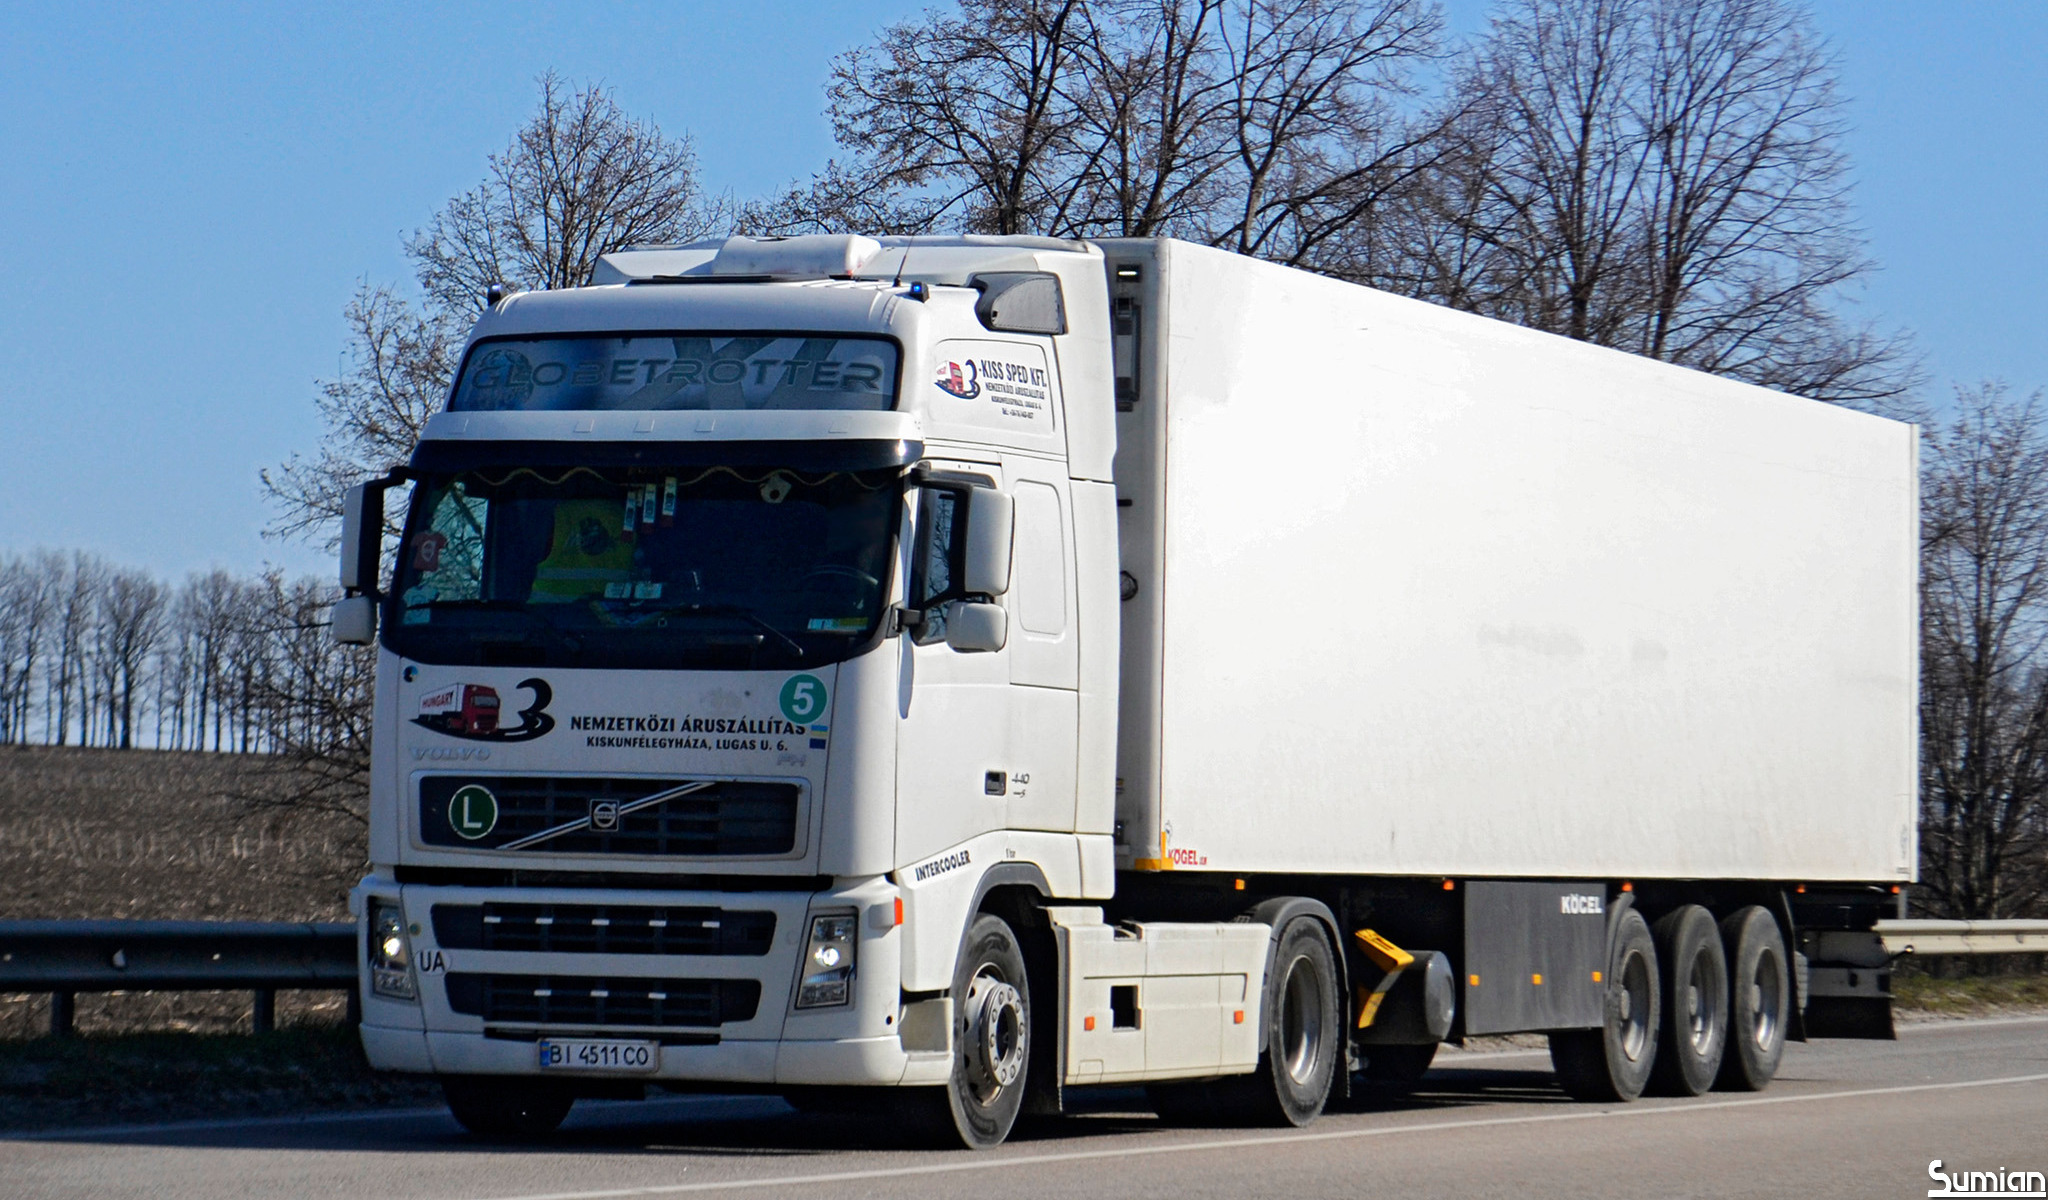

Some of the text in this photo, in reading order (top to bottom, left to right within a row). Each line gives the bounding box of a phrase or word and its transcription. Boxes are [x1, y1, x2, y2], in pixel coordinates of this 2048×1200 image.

[471, 358, 882, 391] GLOBETROTTER
[981, 359, 1004, 380] KISS
[1006, 363, 1028, 384] SPED
[791, 682, 814, 715] 5
[570, 714, 676, 732] NEMZETKÖZI
[586, 735, 789, 751] KISKUNFÉLEGYHÁZA, LUGAS U. 6.
[408, 747, 491, 761] VOLVO
[463, 795, 483, 828] L
[915, 850, 971, 881] INTERCOOLER
[1561, 893, 1603, 914] KÖGEL
[420, 951, 446, 972] UA
[550, 1045, 649, 1066] BI 4511 CO
